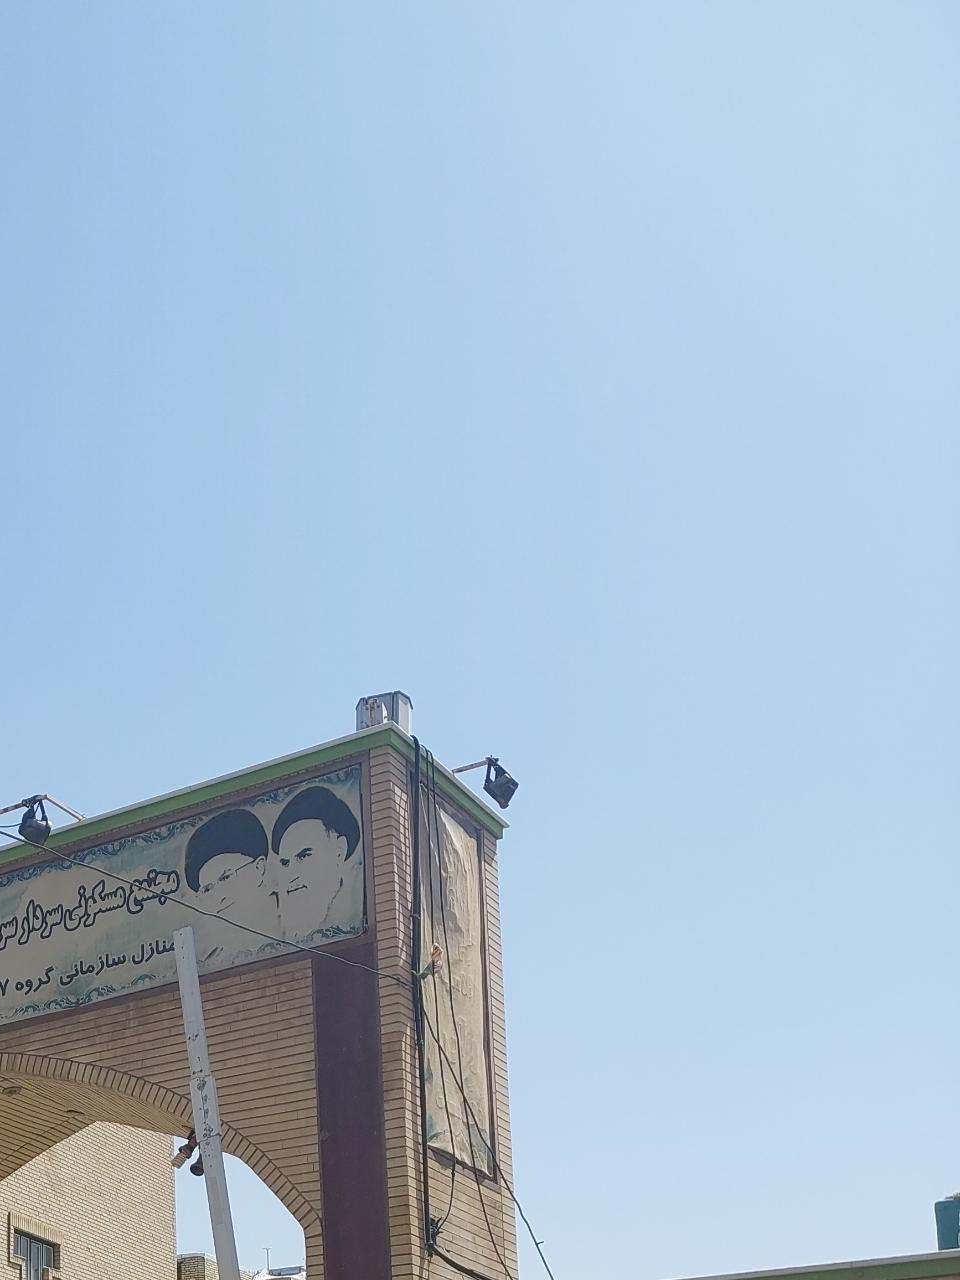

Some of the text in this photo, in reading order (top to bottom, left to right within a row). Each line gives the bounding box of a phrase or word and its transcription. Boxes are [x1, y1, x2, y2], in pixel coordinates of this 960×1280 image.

[63, 879, 126, 931] مسکونی
[126, 869, 180, 914] مجتمع
[18, 898, 64, 946] سردار
[15, 965, 55, 996] گروه
[59, 952, 127, 986] سازمانی
